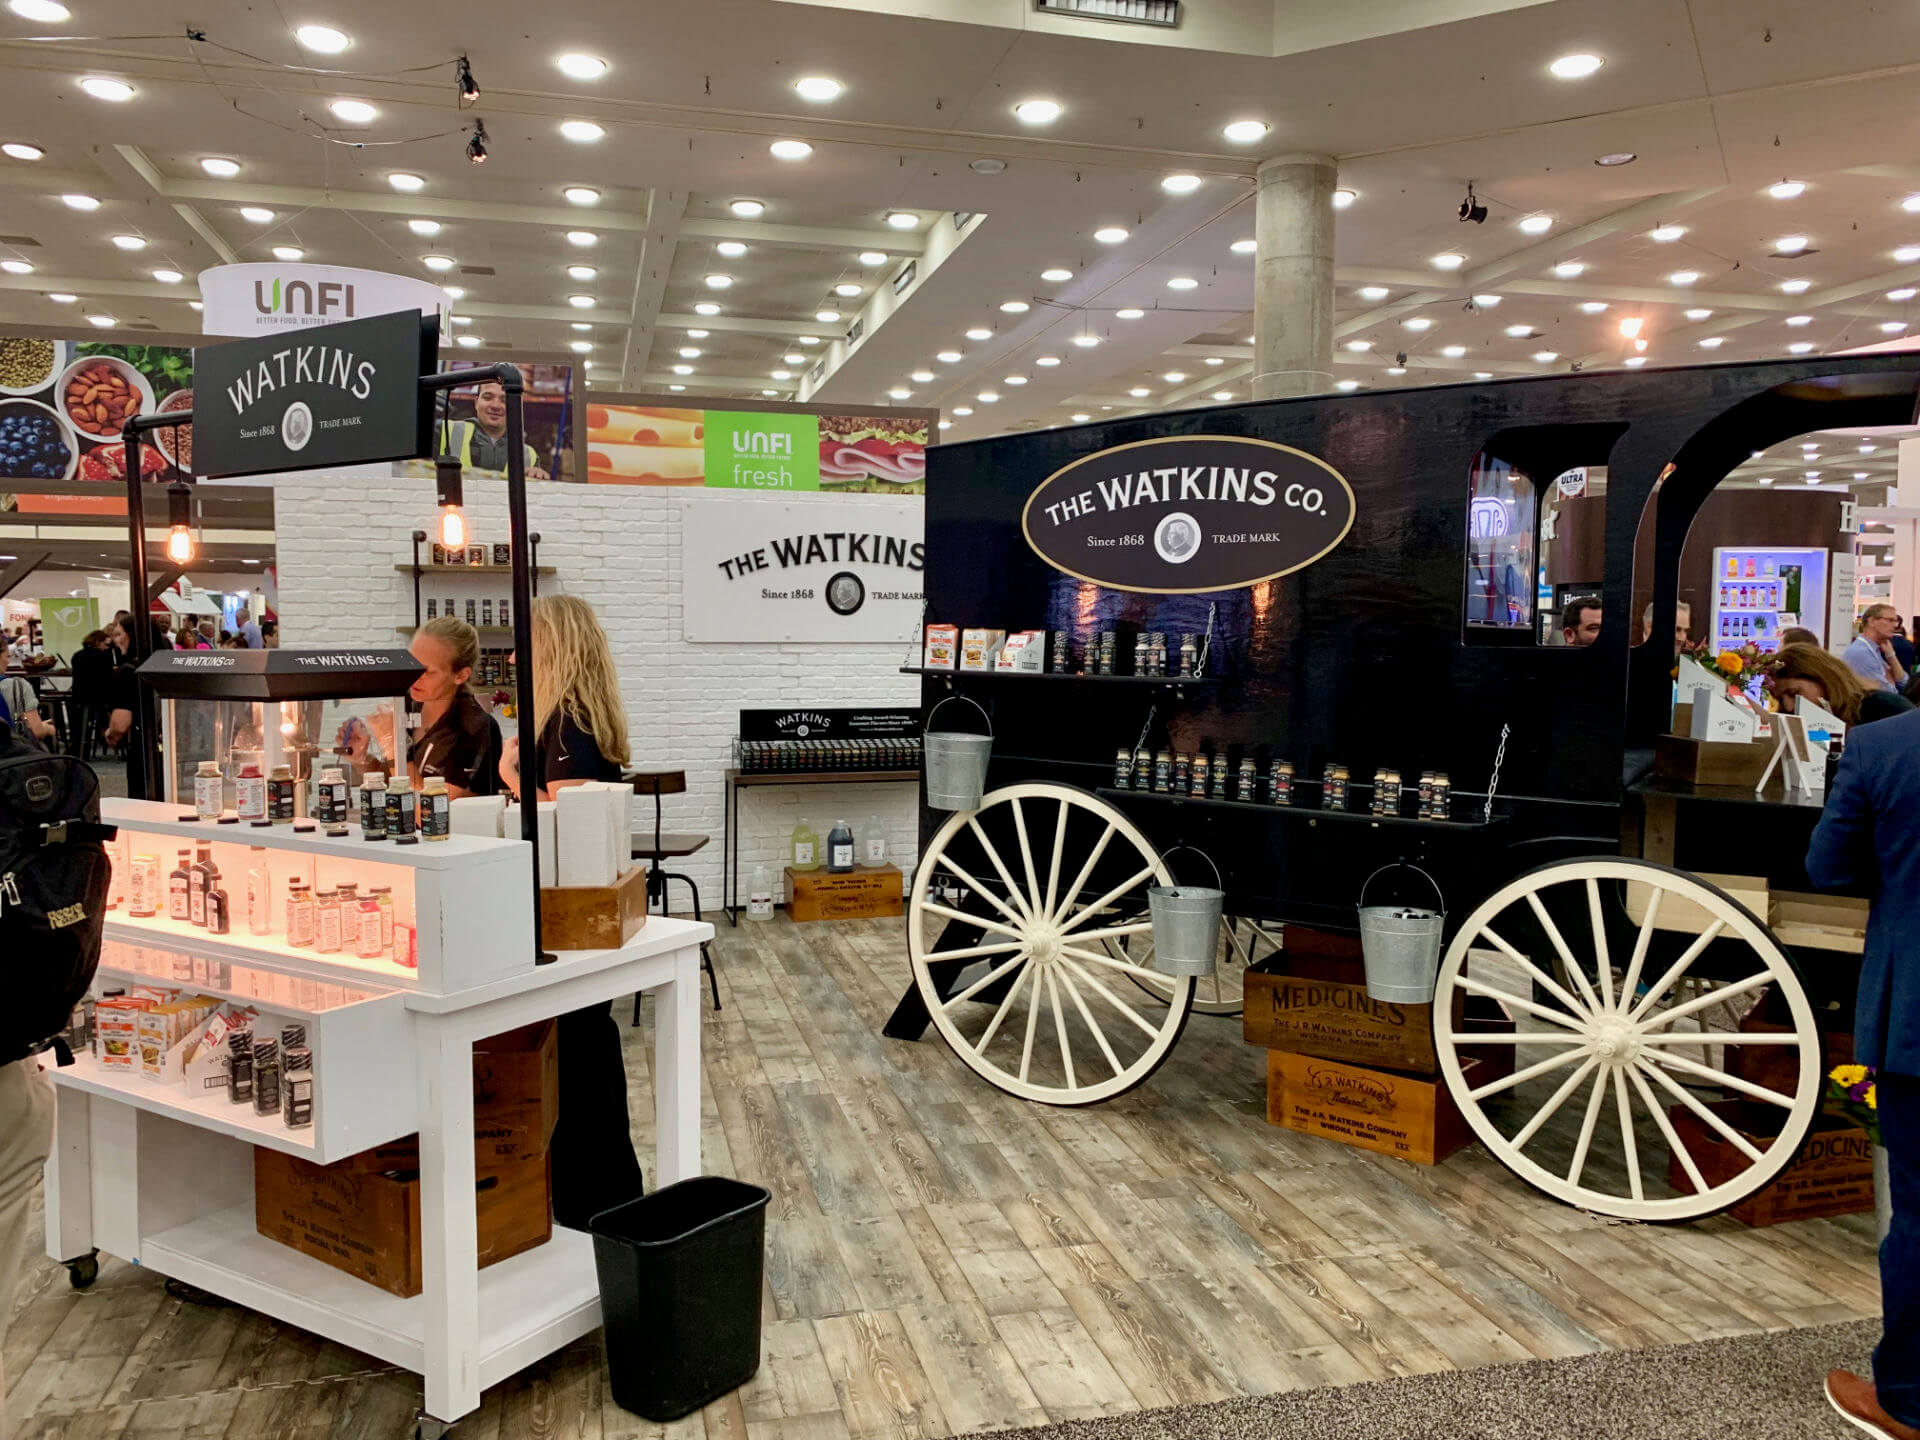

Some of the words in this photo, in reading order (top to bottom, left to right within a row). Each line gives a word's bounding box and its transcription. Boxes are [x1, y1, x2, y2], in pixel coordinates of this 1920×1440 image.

[255, 277, 354, 318] UNFI
[227, 345, 376, 416] WATKINS
[240, 428, 258, 439] Since
[259, 425, 275, 436] 1868
[320, 419, 341, 430] TRADE
[342, 416, 362, 427] MARK
[733, 430, 791, 454] UNFI
[733, 464, 793, 487] fresh
[1561, 473, 1584, 485] ULTRA
[1045, 491, 1096, 526] THE
[1096, 466, 1279, 512] WATKINS
[1285, 483, 1327, 516] CO.
[1087, 535, 1116, 547] Since
[1118, 534, 1145, 546] 1868
[1212, 533, 1247, 544] TRADE
[1249, 532, 1281, 543] MARK
[718, 548, 769, 580] THE
[770, 532, 925, 571] WATKINS
[762, 588, 788, 599] Since
[790, 589, 814, 599] 1868
[872, 591, 900, 600] TRADE
[185, 656, 225, 667] WATKINS
[297, 657, 319, 665] THE
[317, 655, 376, 666] WATKINS
[775, 712, 831, 728] WATKINS
[1272, 984, 1407, 1027] MEDICINES
[1274, 1018, 1290, 1028] THE
[1312, 1023, 1353, 1037] WATKINS
[1355, 1029, 1401, 1041] COMPANY
[1336, 1076, 1384, 1102] WATKINS
[1295, 1105, 1310, 1116] THE
[1328, 1113, 1365, 1129] WATKINS
[1367, 1123, 1408, 1139] COMPANY
